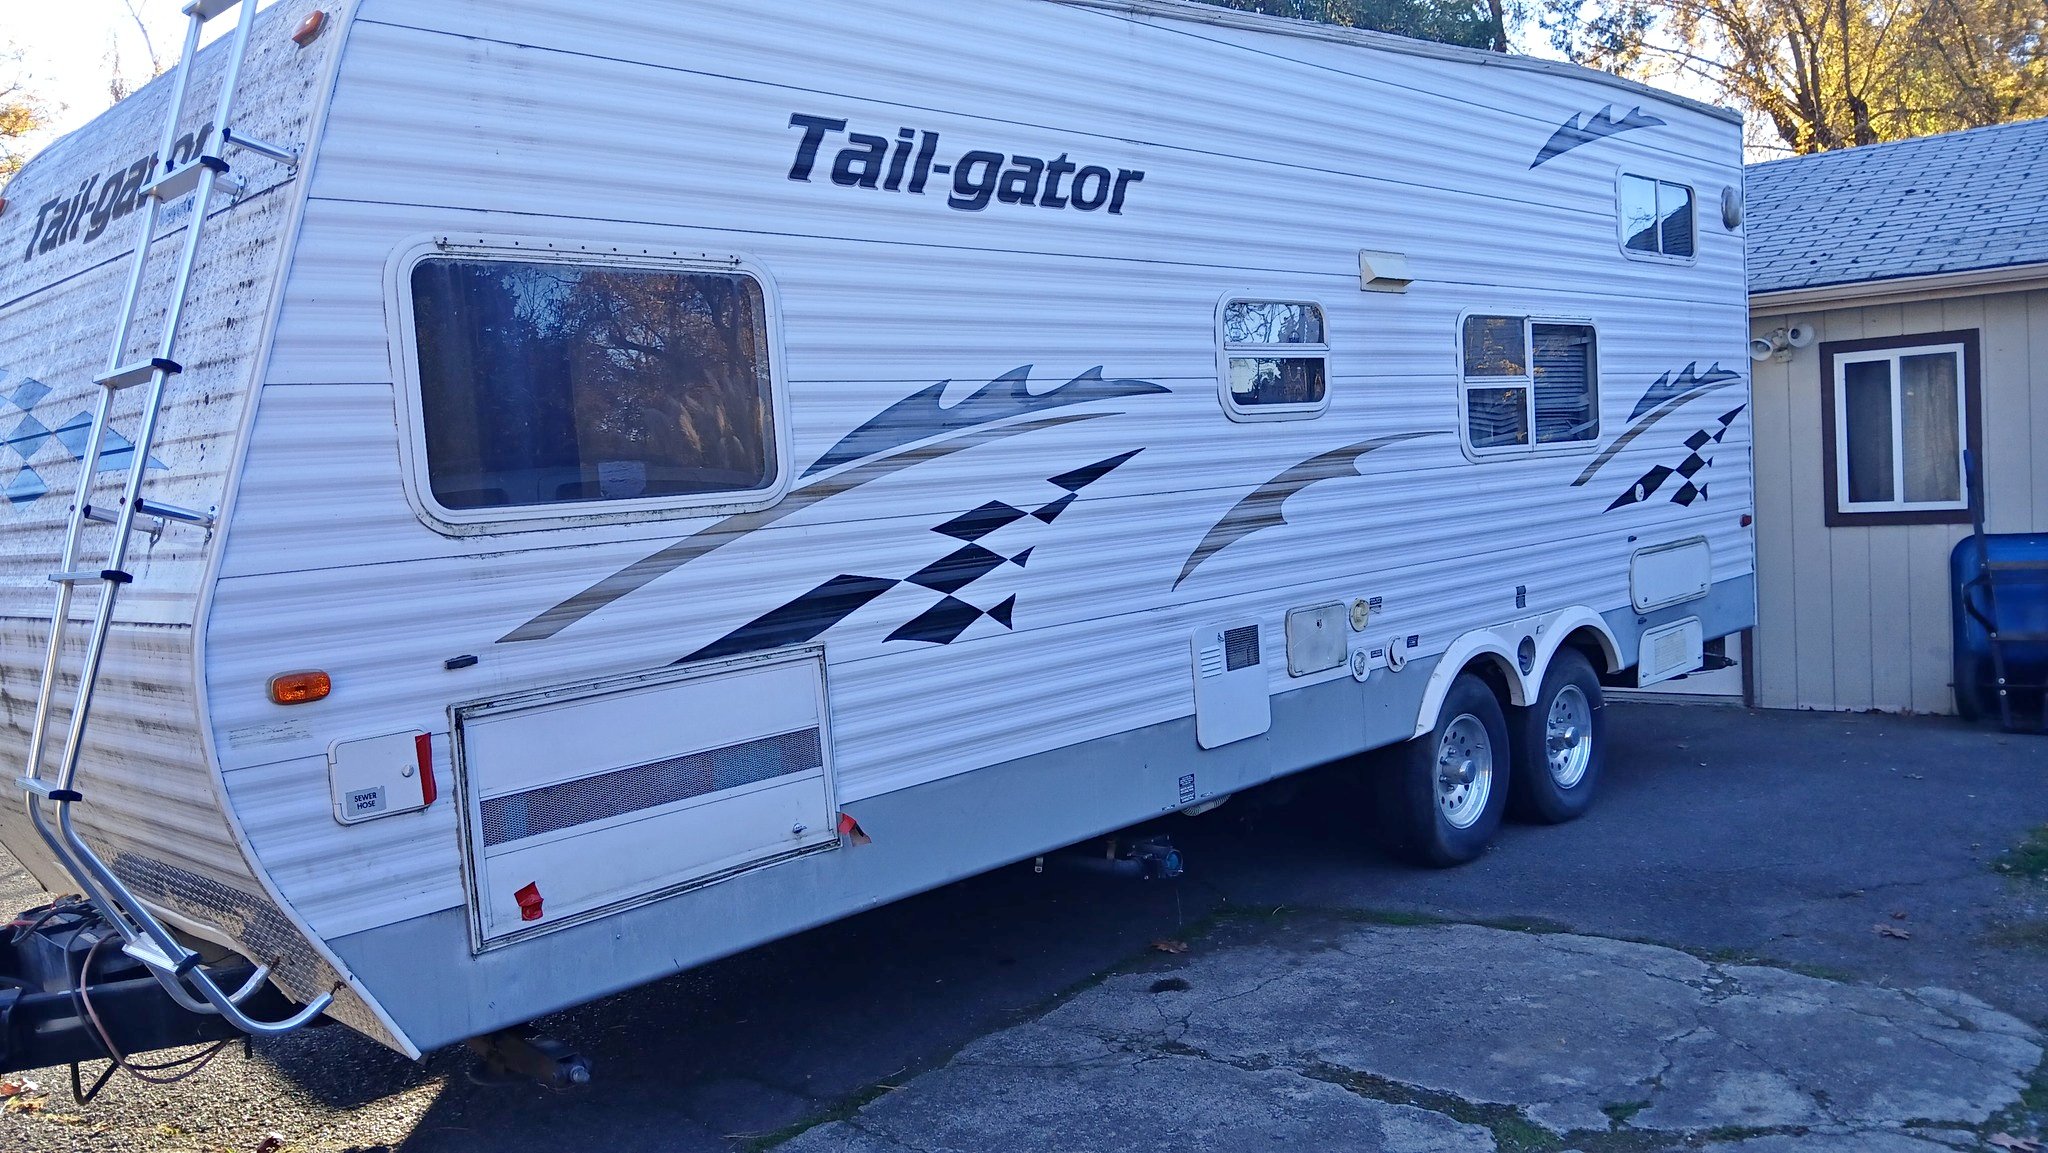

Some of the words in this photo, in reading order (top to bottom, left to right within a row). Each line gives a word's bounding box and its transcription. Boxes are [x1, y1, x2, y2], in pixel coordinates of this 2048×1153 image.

[787, 111, 1146, 216] Tail-gator
[354, 791, 377, 803] SEWER
[356, 800, 376, 810] HOSE
